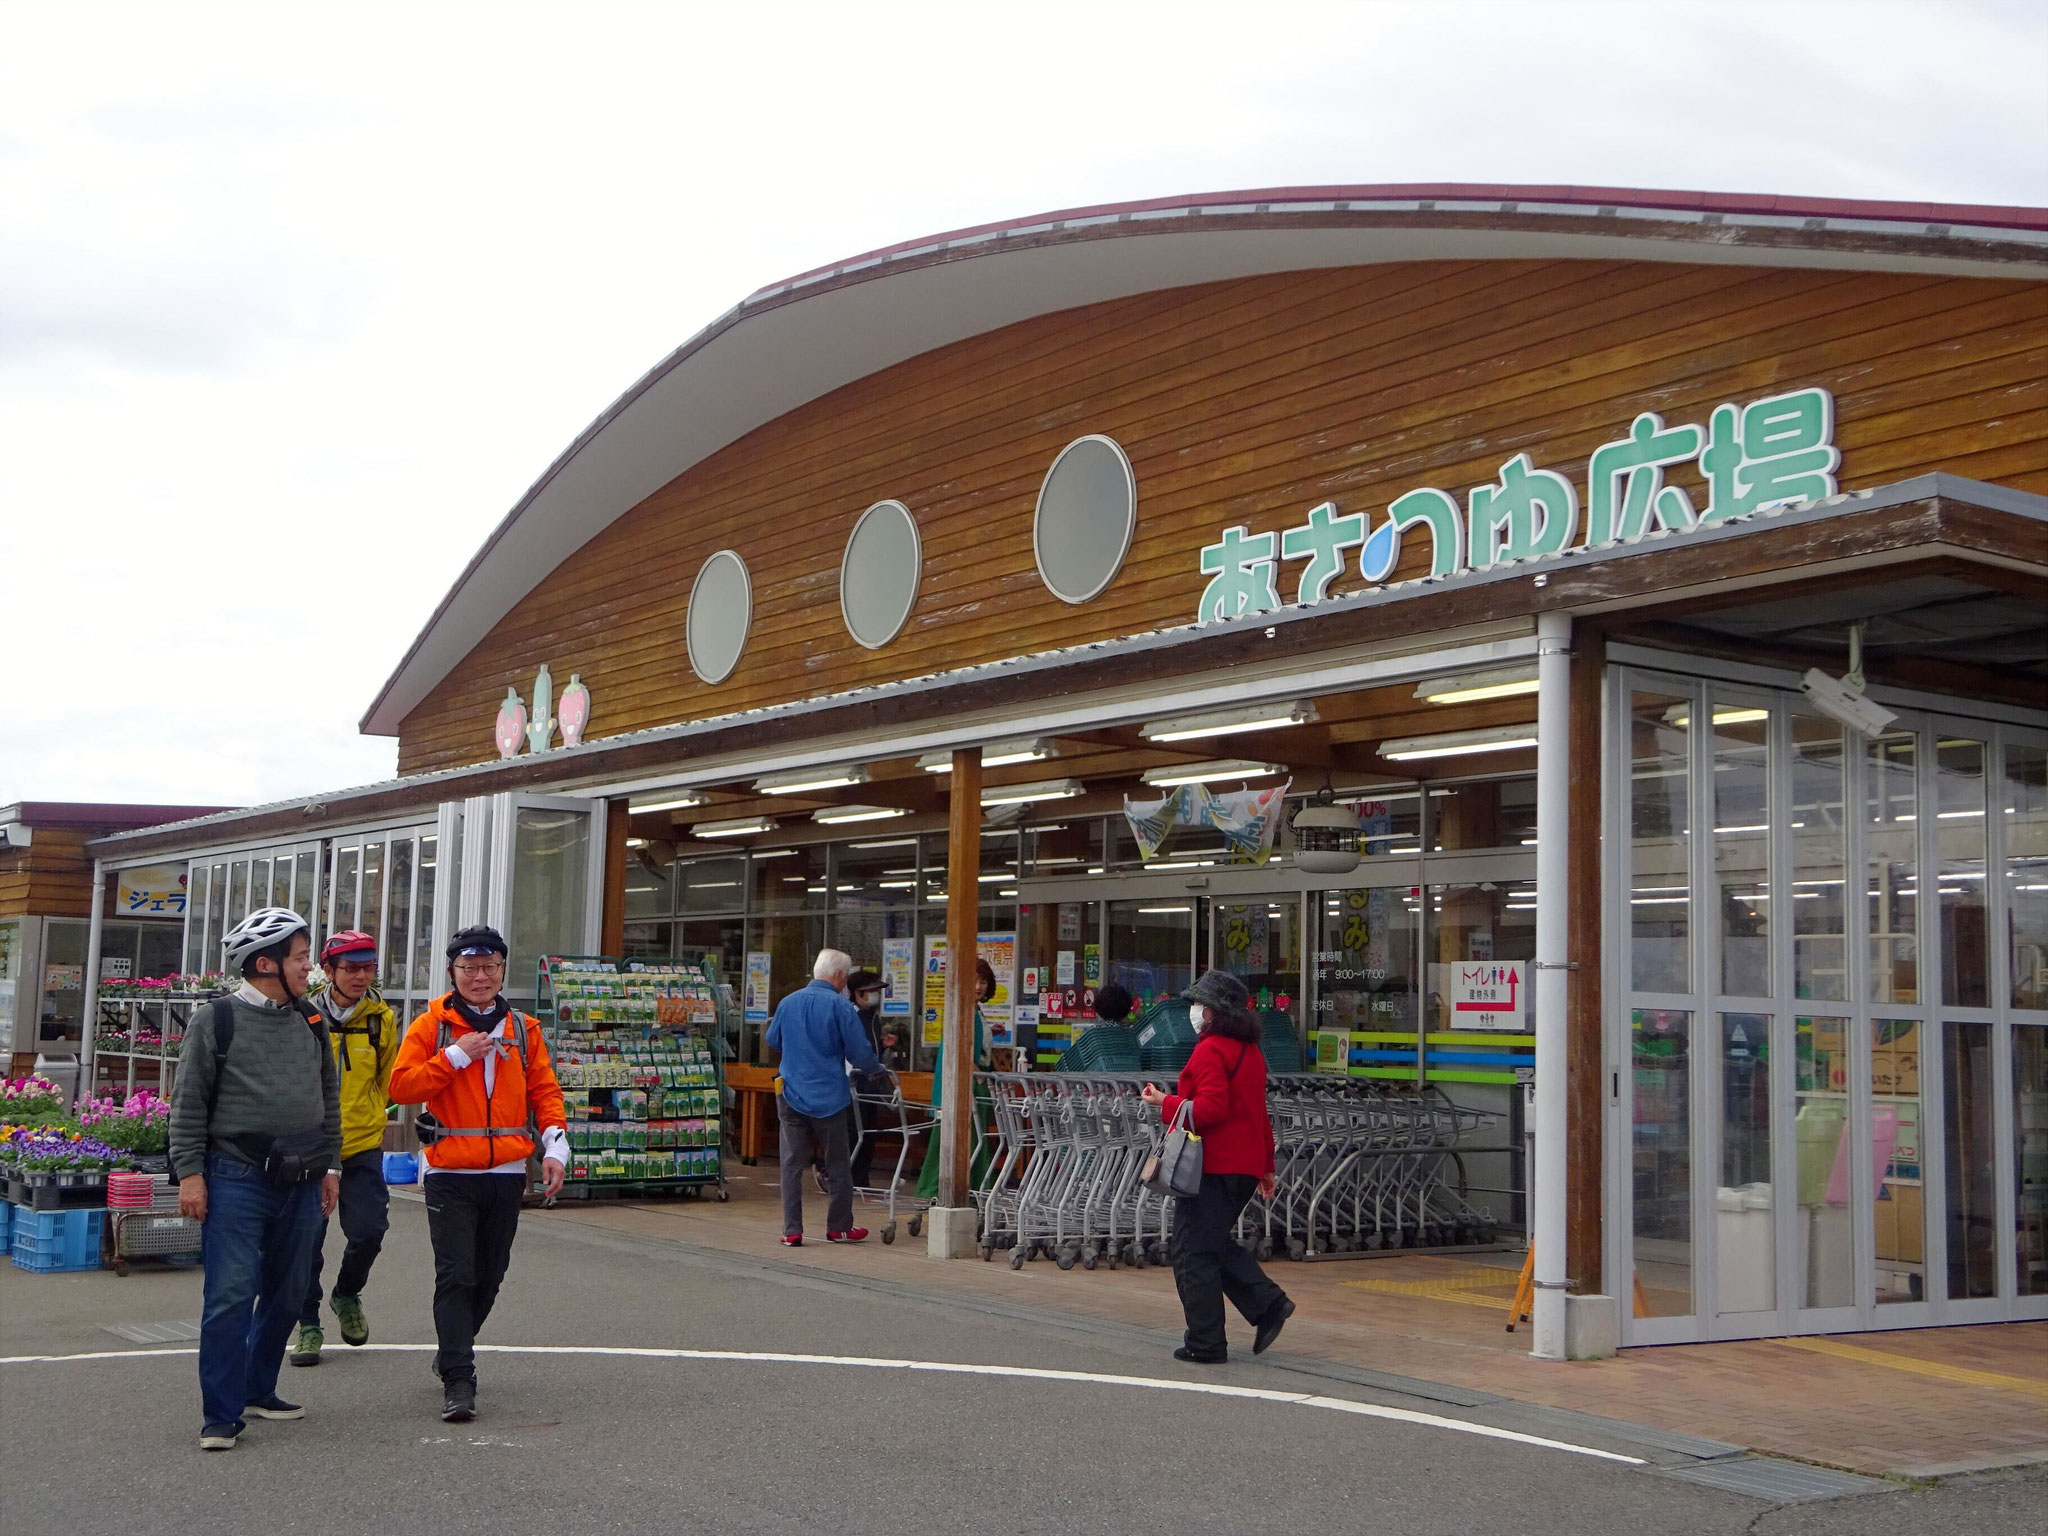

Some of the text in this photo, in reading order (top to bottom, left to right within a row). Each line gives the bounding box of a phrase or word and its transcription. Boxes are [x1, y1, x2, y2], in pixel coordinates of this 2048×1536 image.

[1198, 387, 1841, 622] あさつゆ広場
[1312, 951, 1343, 963] 営業時間
[1462, 966, 1491, 986] トイレ
[1312, 1000, 1334, 1012] 定休日
[1371, 1001, 1394, 1012] 水曜日
